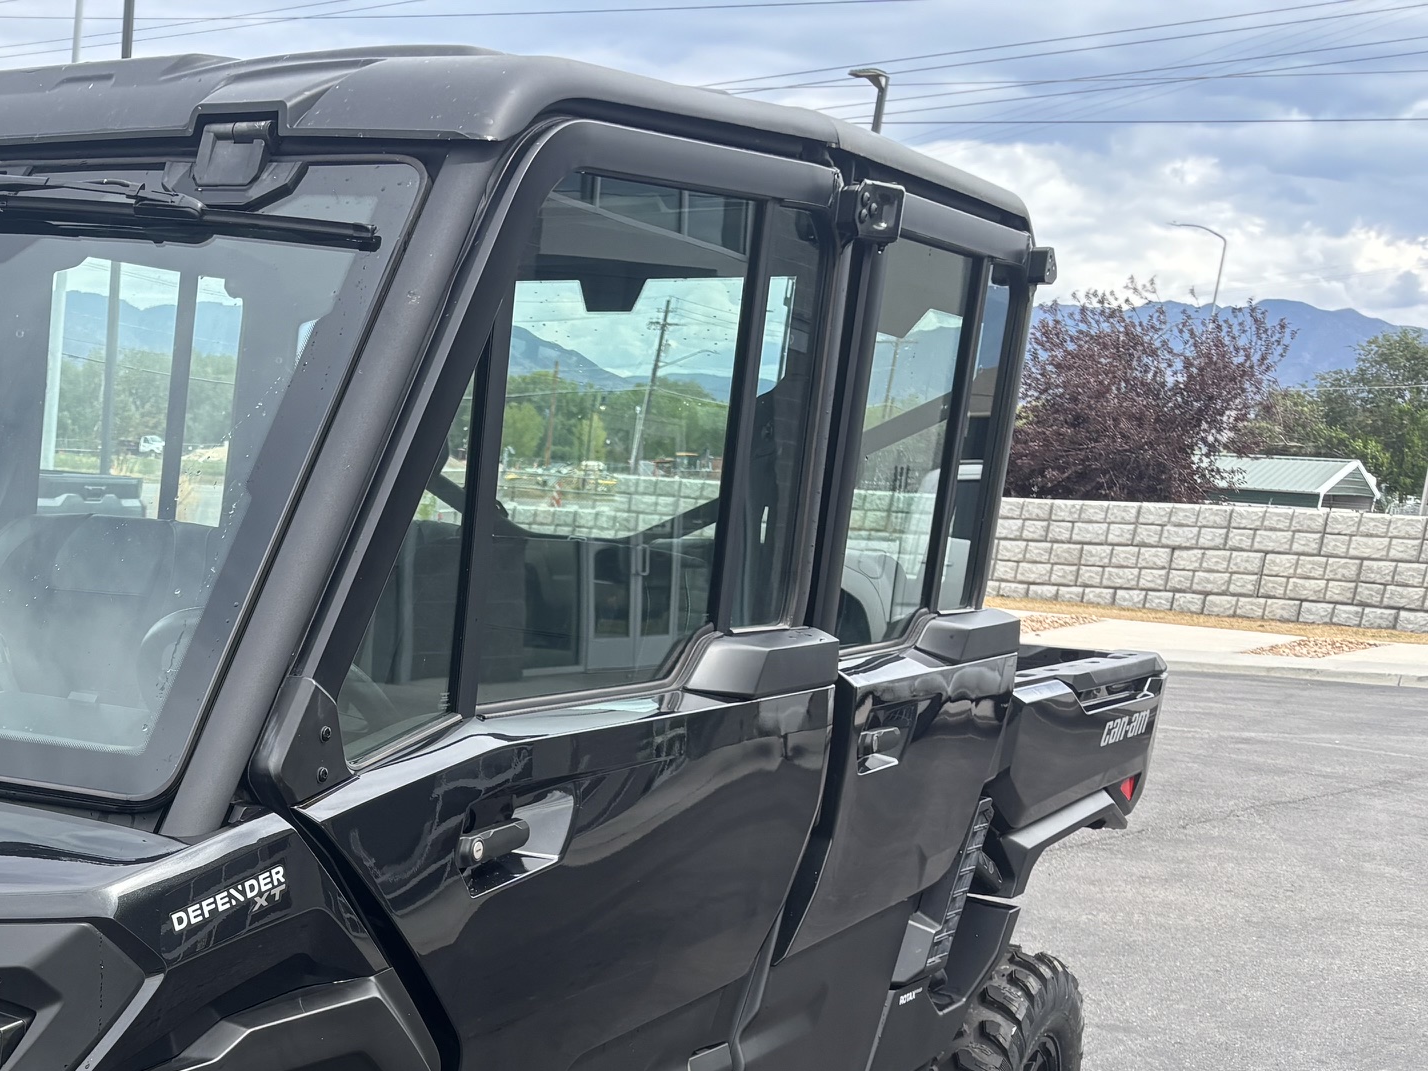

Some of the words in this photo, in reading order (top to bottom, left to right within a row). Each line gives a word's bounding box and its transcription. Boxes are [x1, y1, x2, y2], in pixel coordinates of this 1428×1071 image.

[1100, 709, 1150, 747] can-am
[171, 866, 285, 931] DEFENDER
[252, 884, 286, 911] XT
